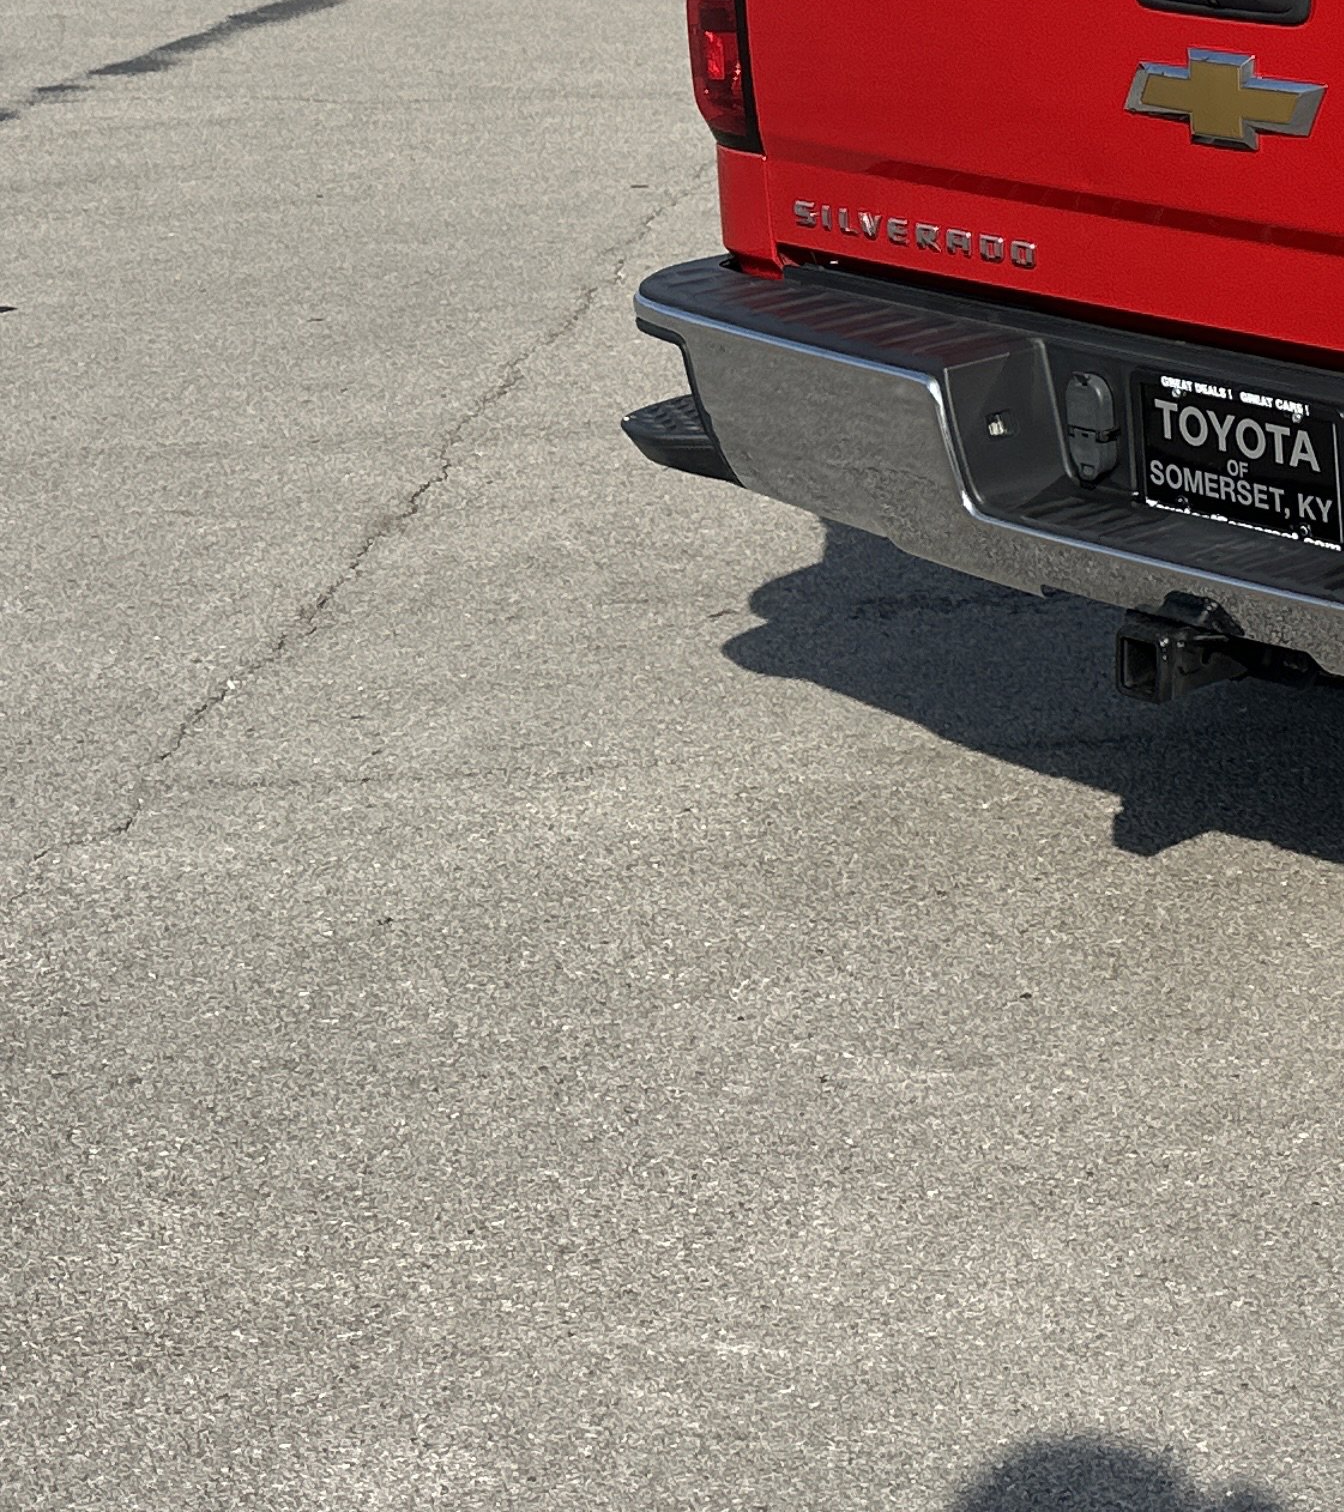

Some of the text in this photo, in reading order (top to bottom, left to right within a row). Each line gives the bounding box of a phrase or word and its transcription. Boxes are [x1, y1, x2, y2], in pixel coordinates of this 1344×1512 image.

[793, 199, 1037, 269] SILVERADO
[1160, 375, 1193, 392] GREAT
[1239, 391, 1273, 408] GREAT
[1154, 398, 1321, 472] TOYOTA
[1150, 459, 1332, 523] SOMERSET, KY
[1227, 458, 1249, 478] OF
